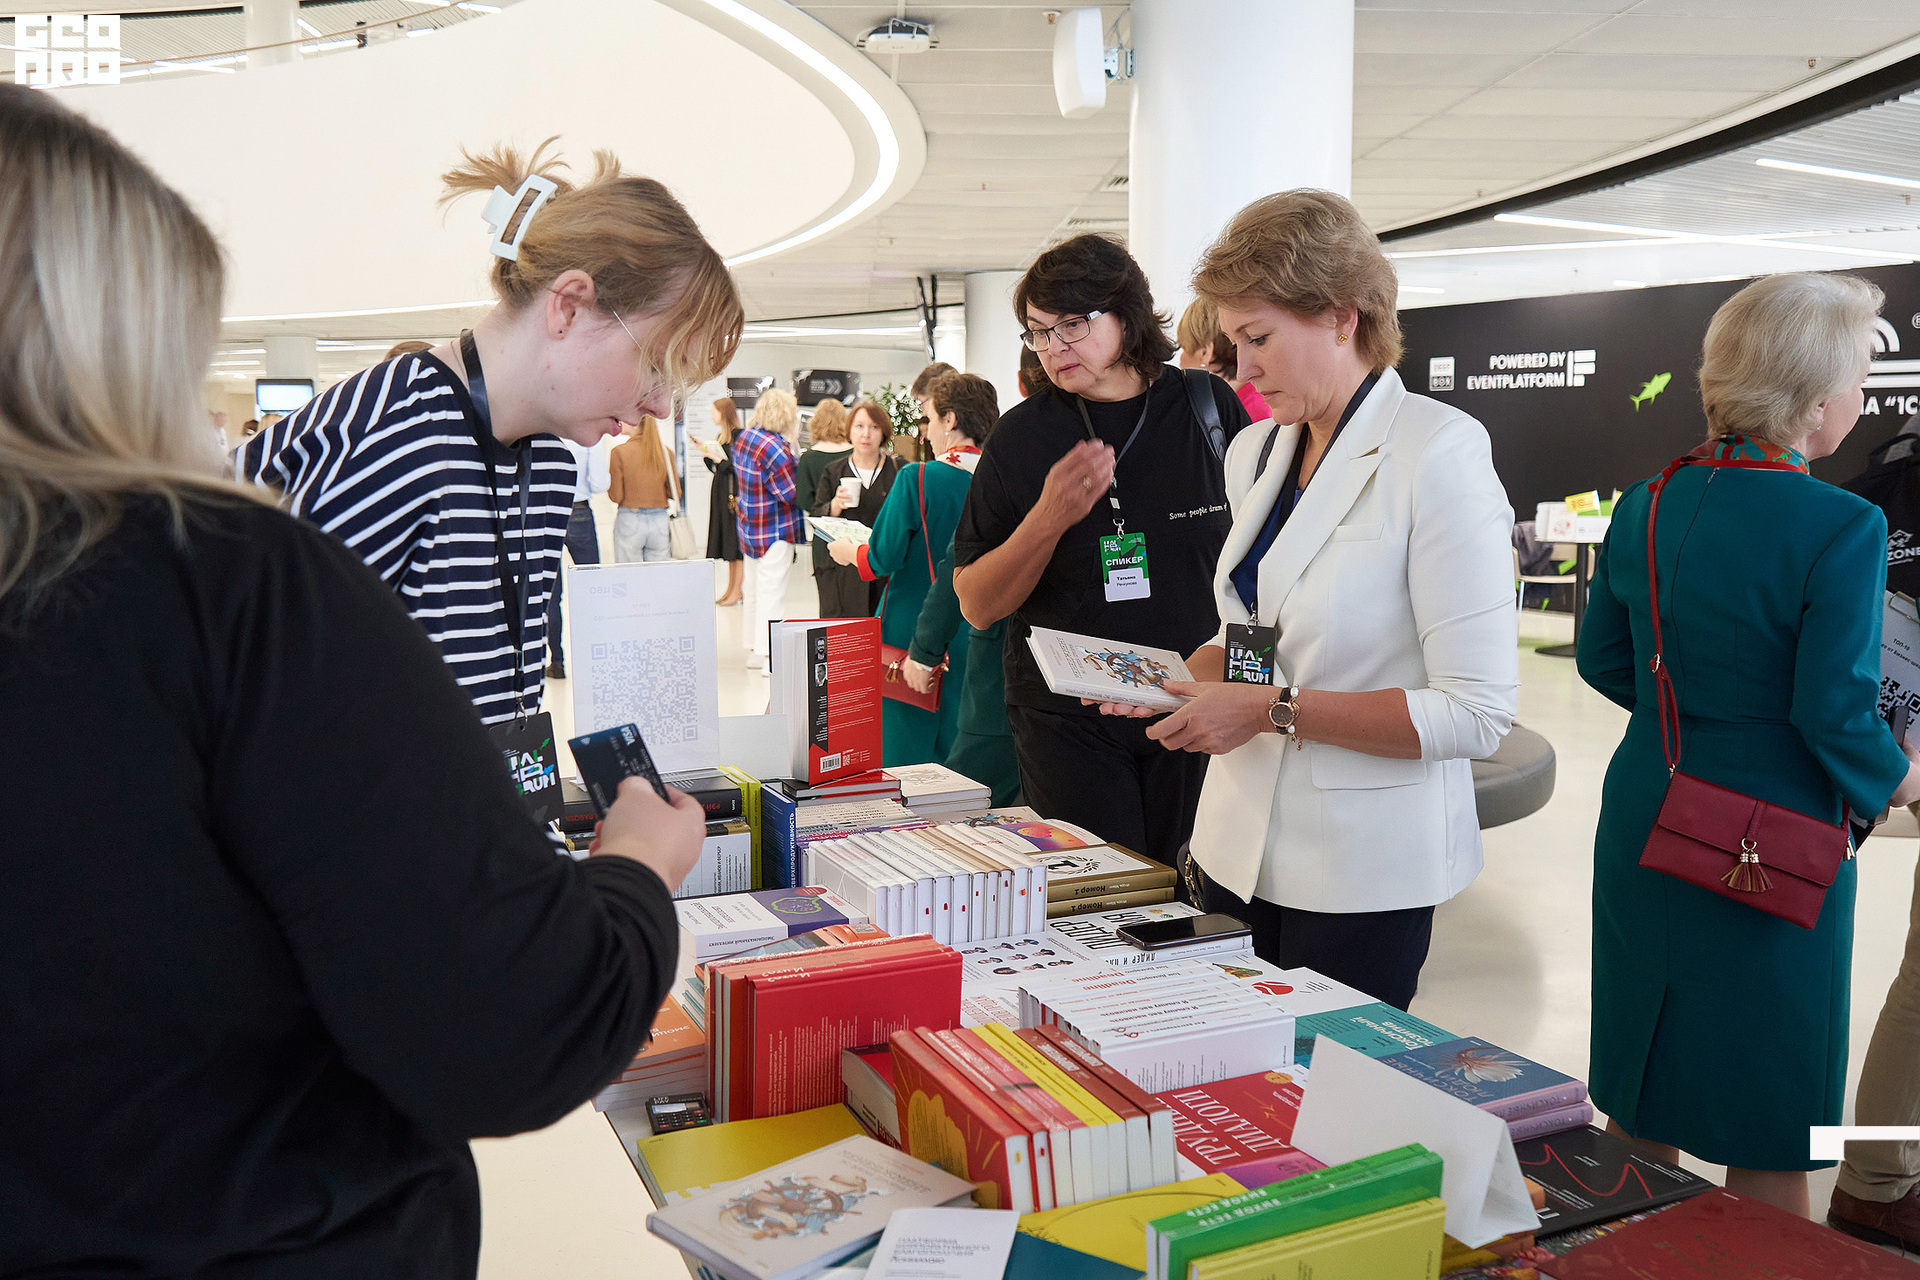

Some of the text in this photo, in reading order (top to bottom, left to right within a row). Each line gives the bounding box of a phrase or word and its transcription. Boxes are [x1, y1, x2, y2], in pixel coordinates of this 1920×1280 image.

[1489, 351, 1567, 370] POWERED BY
[1467, 372, 1566, 390] EVENTPLATFORM
[1169, 512, 1187, 520] Some
[1189, 507, 1208, 517] people
[1105, 555, 1144, 567] СПИКЕР
[620, 726, 636, 746] VISA
[566, 813, 595, 822] РАБОТА
[789, 812, 797, 888] СВЕРХПРОДУКТИВНОСТЬ
[1080, 885, 1106, 894] Номер
[1077, 901, 1102, 911] Номер
[1132, 952, 1156, 964] ЛИДЕР
[1071, 971, 1124, 983] Deadline
[1082, 978, 1136, 991] Deadline
[651, 1024, 690, 1038] ЭМОЦИ
[1172, 1089, 1290, 1152] ДИАЛОГИ
[1155, 1097, 1241, 1165] ТРУДН
